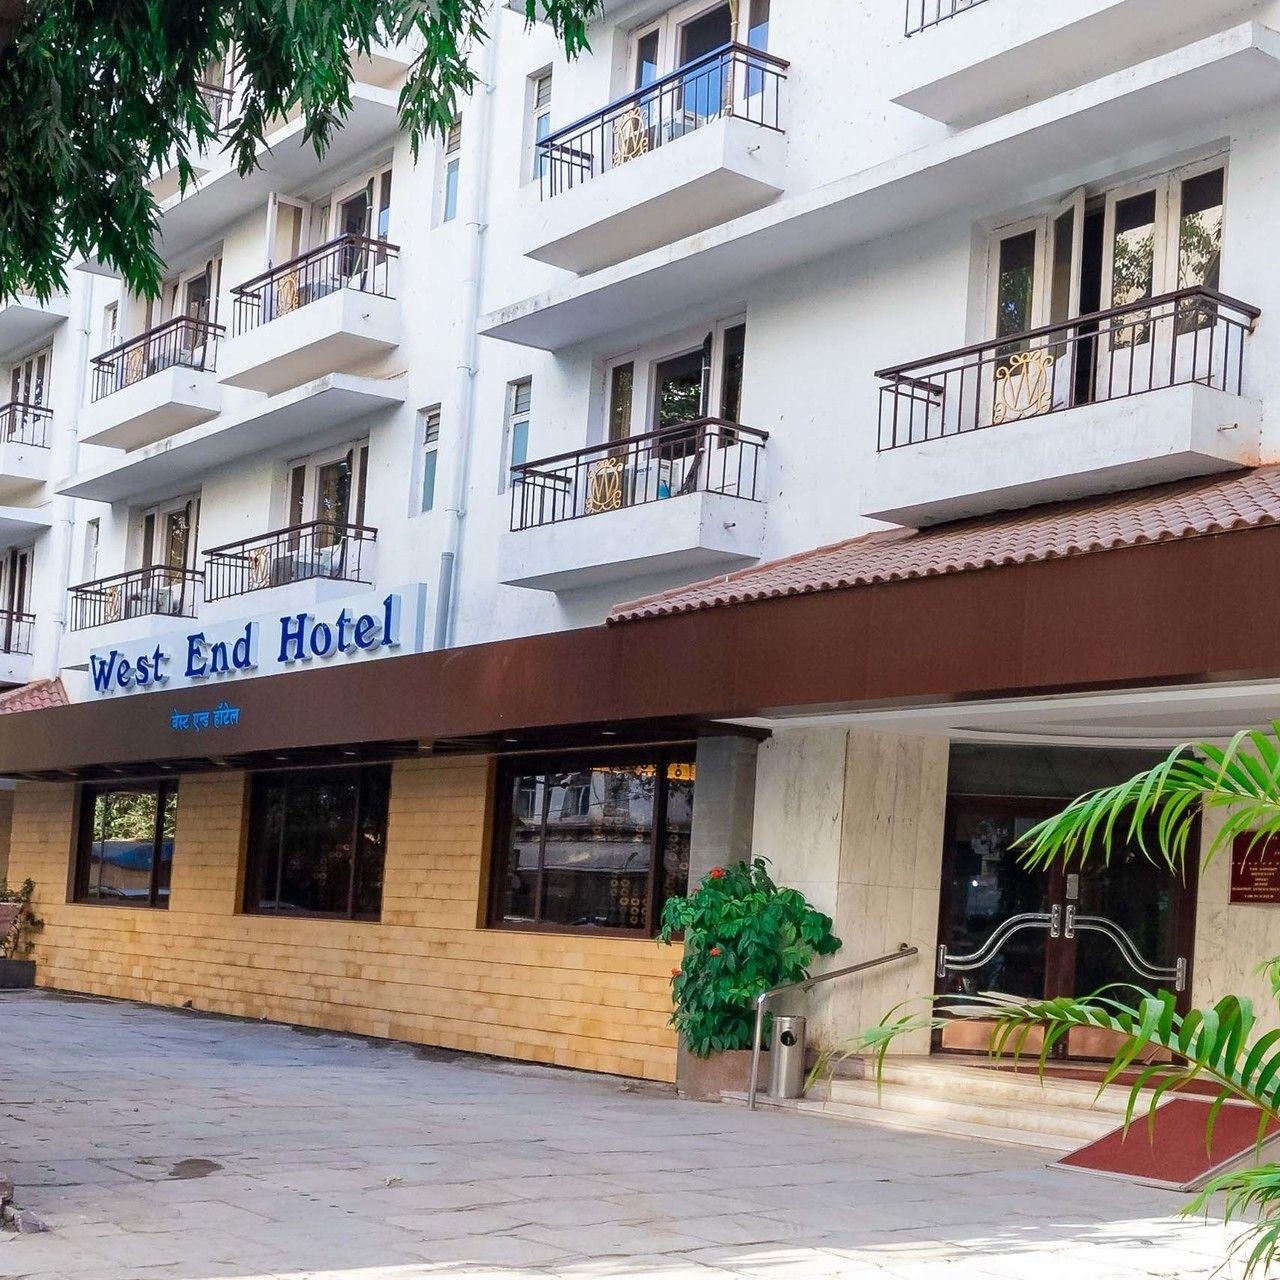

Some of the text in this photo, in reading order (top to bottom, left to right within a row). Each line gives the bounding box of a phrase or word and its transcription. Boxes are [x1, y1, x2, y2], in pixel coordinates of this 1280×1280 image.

[89, 593, 396, 691] West End Hotel
